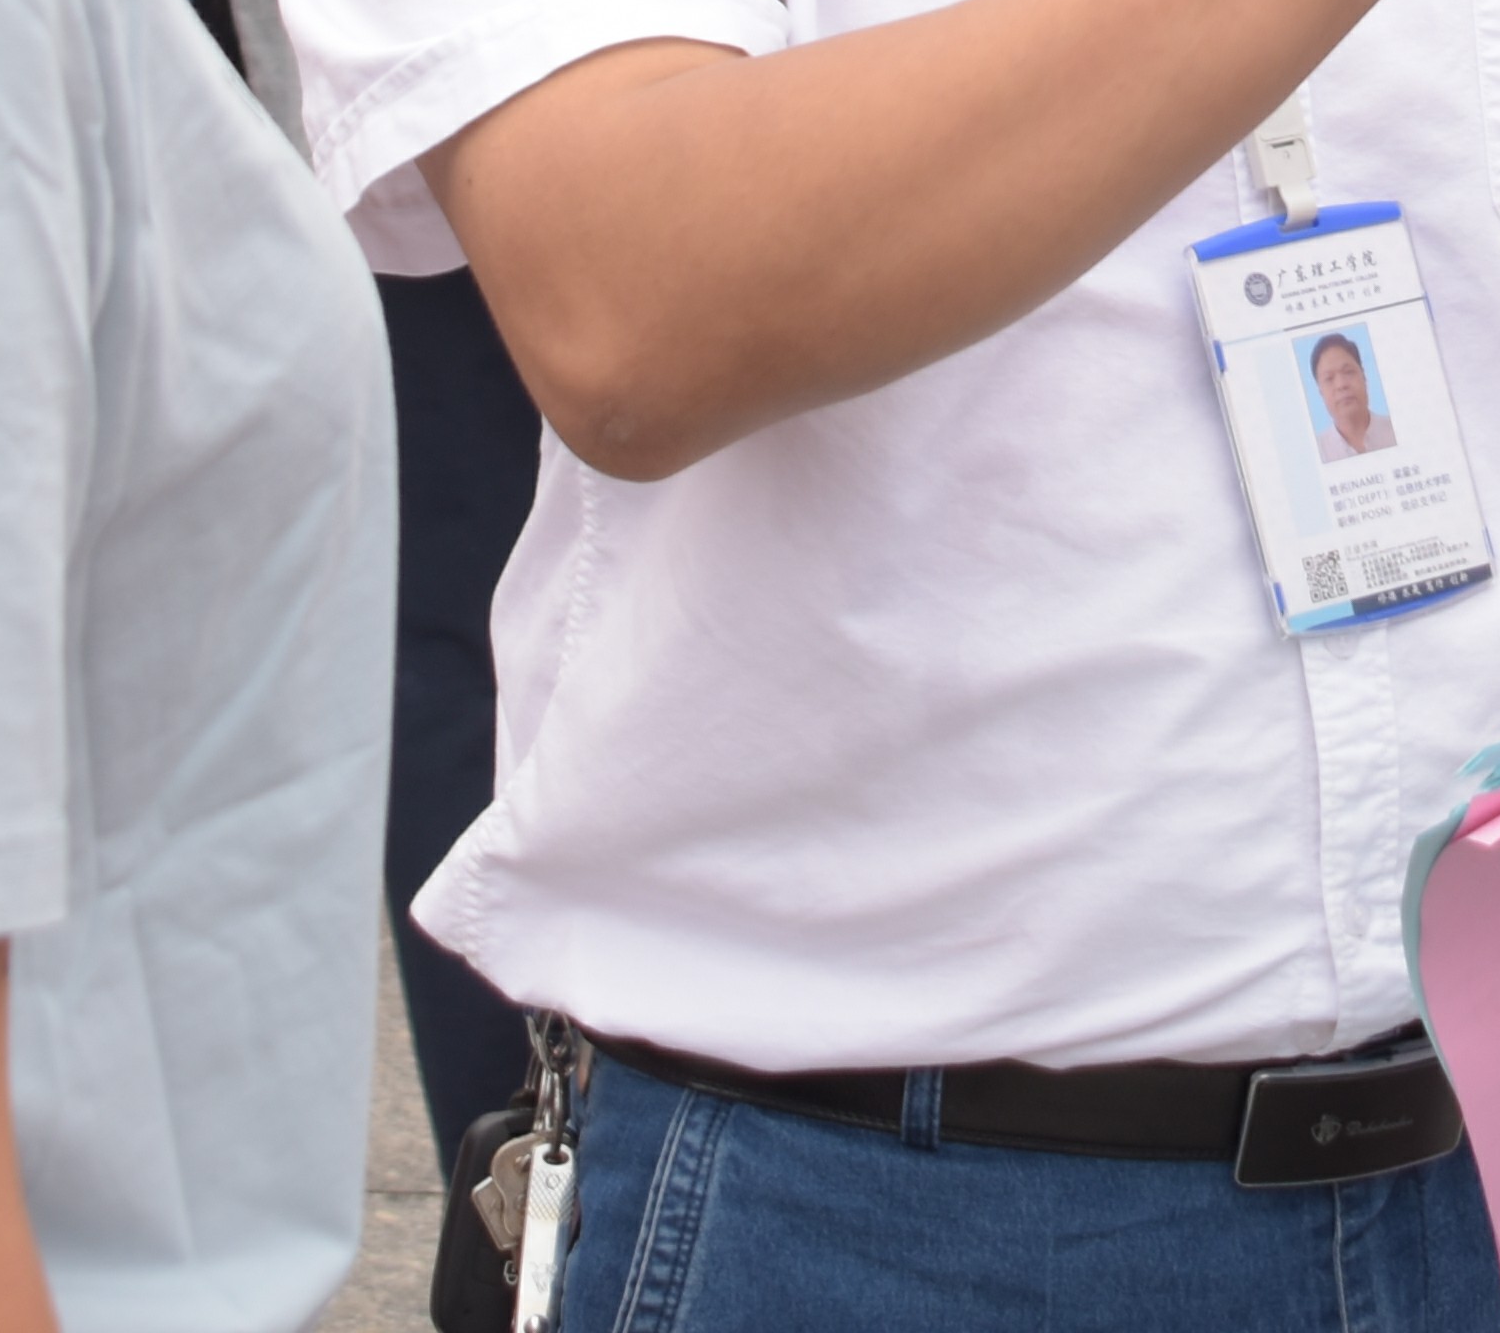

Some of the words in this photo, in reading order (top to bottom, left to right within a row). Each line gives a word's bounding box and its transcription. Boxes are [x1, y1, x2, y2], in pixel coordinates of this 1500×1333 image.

[1273, 246, 1378, 288] 广东理工学院
